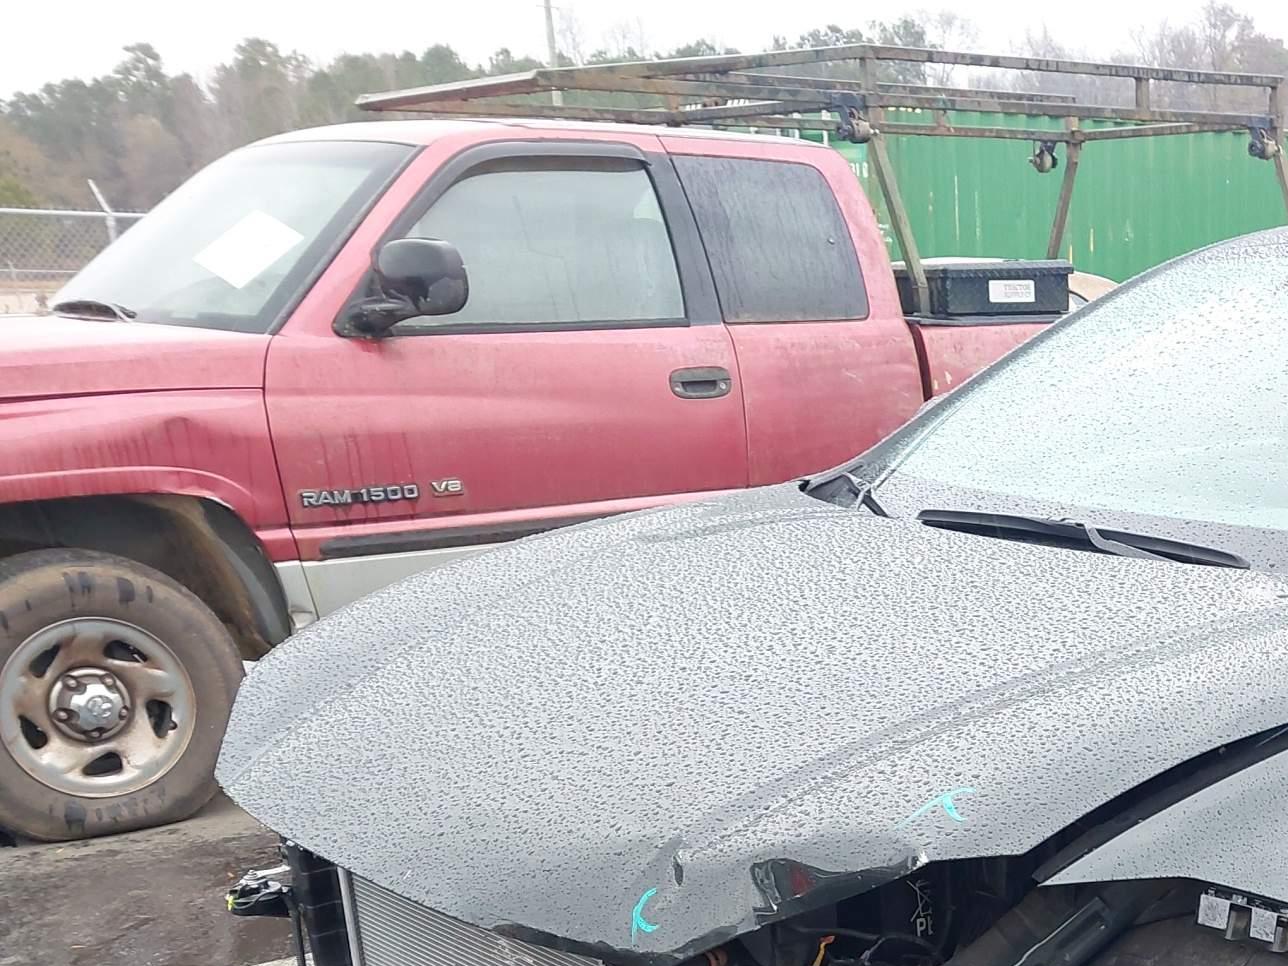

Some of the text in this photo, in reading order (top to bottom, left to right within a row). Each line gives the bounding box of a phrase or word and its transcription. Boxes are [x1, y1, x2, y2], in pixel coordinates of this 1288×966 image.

[301, 479, 464, 507] RAM 1500 V8
